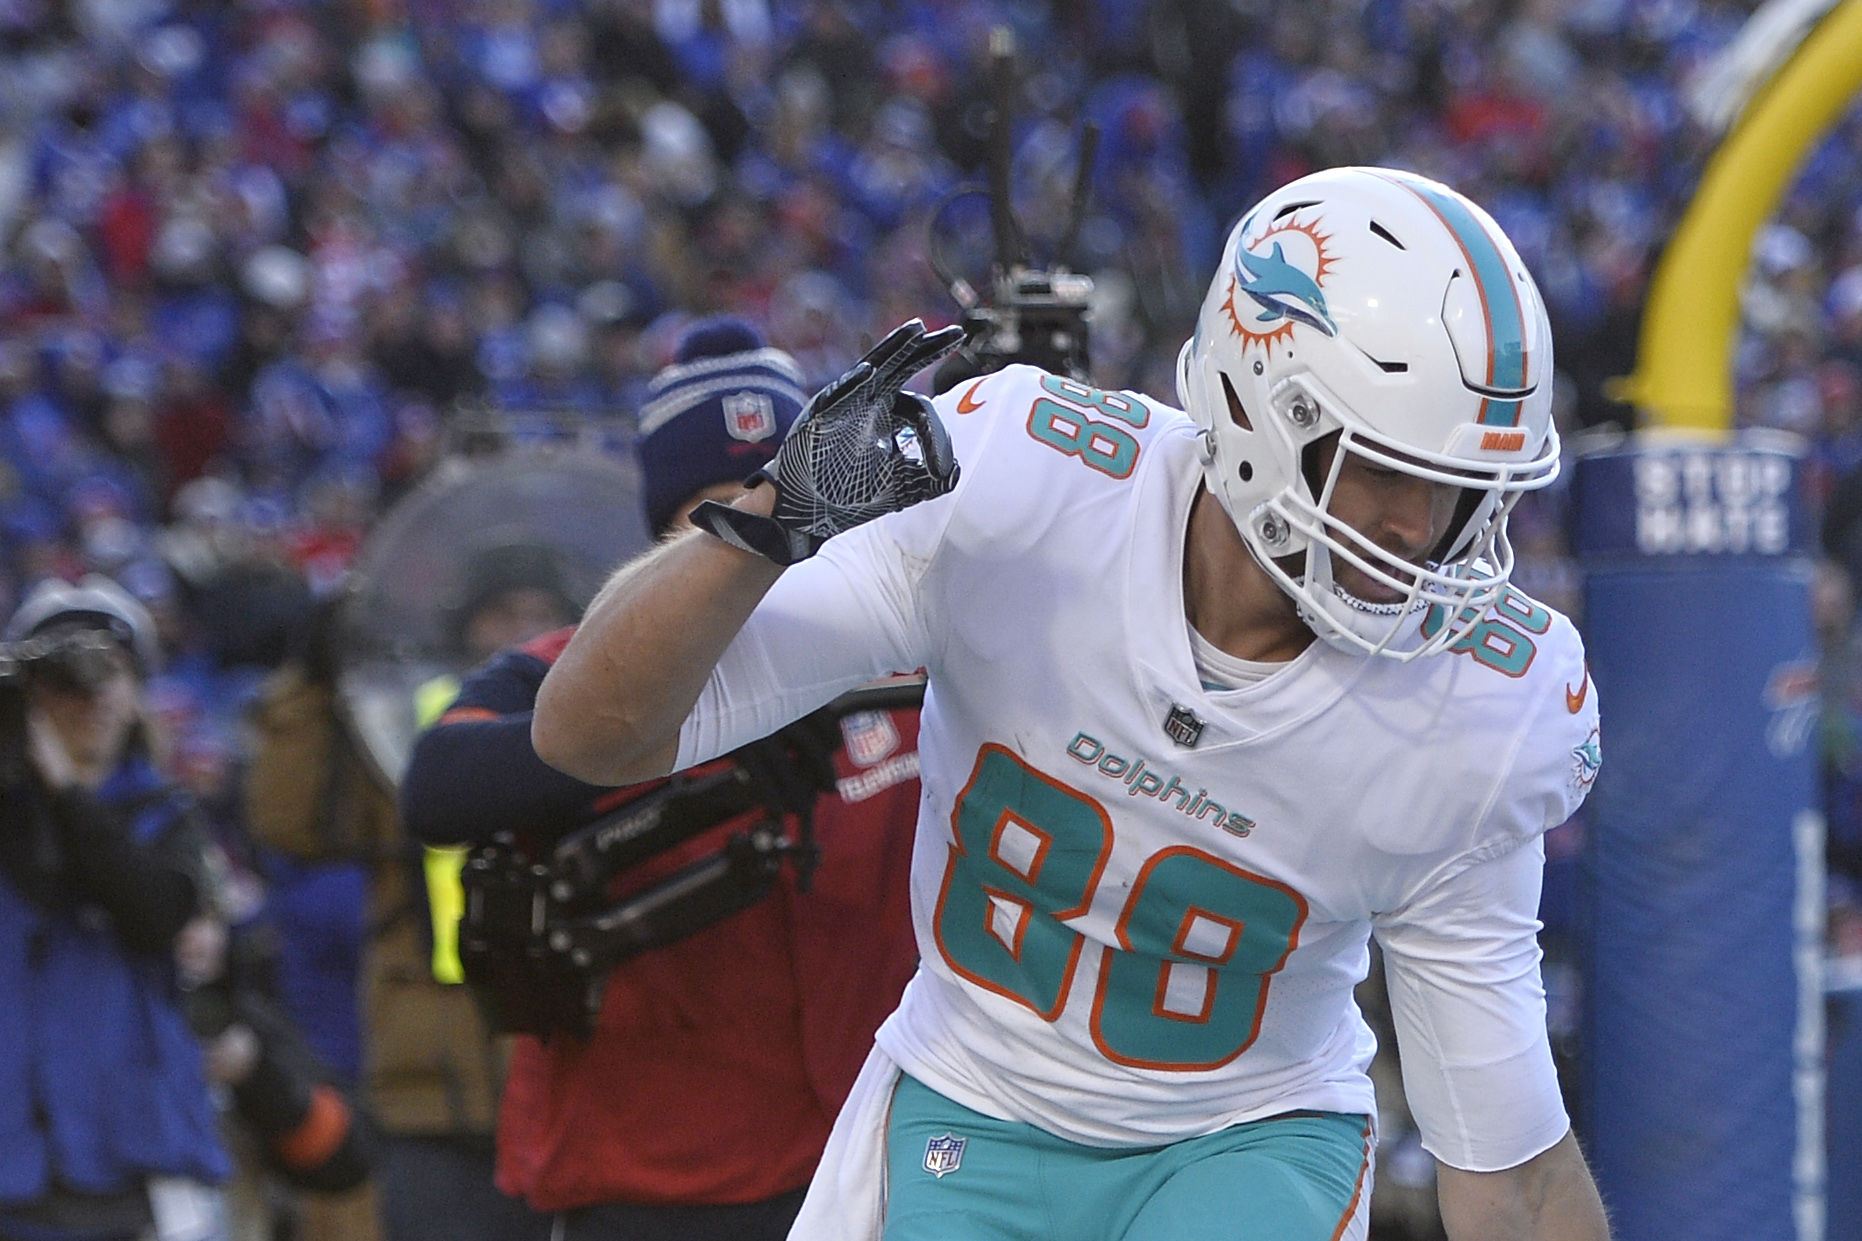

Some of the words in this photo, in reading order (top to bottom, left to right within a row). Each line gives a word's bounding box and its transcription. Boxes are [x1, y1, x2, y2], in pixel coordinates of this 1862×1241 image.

[1026, 374, 1151, 480] 88
[1633, 455, 1791, 503] STOP
[1168, 718, 1197, 745] NFL
[1067, 731, 1256, 838] Dolphins
[933, 741, 1309, 1073] 88
[928, 1150, 956, 1169] NFL
